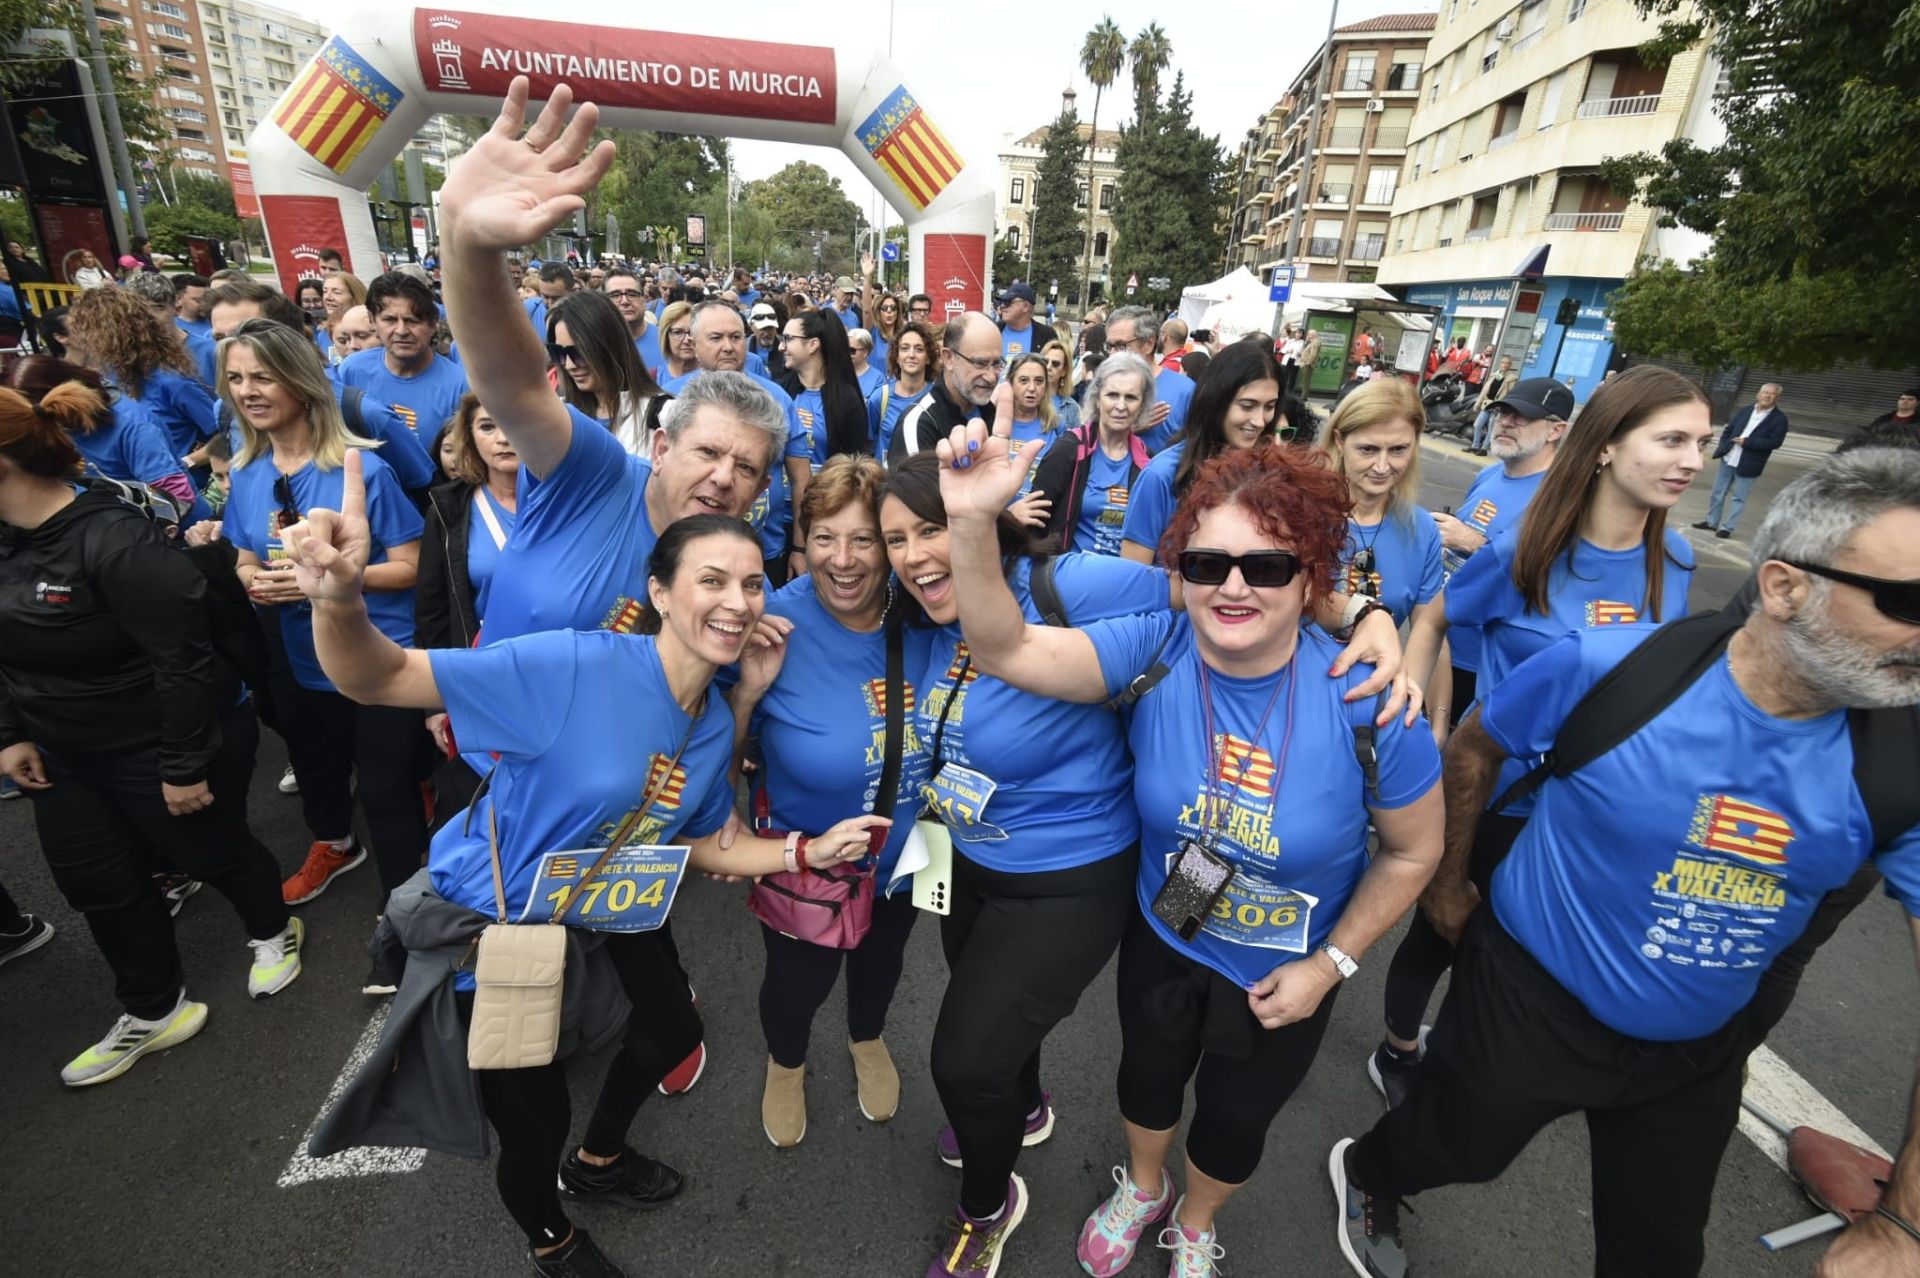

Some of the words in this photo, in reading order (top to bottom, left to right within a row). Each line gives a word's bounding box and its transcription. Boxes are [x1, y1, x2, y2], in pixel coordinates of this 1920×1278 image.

[481, 48, 682, 86] AYUNTAMIENTO
[690, 67, 720, 90] DE
[729, 71, 822, 98] MURCIA
[1470, 287, 1494, 304] Roque
[1494, 286, 1511, 300] Mas
[920, 785, 974, 828] 817
[634, 862, 677, 874] VALENCIA
[547, 878, 666, 916] 1704
[1652, 871, 1673, 892] X
[1676, 876, 1786, 908] VALENCIA
